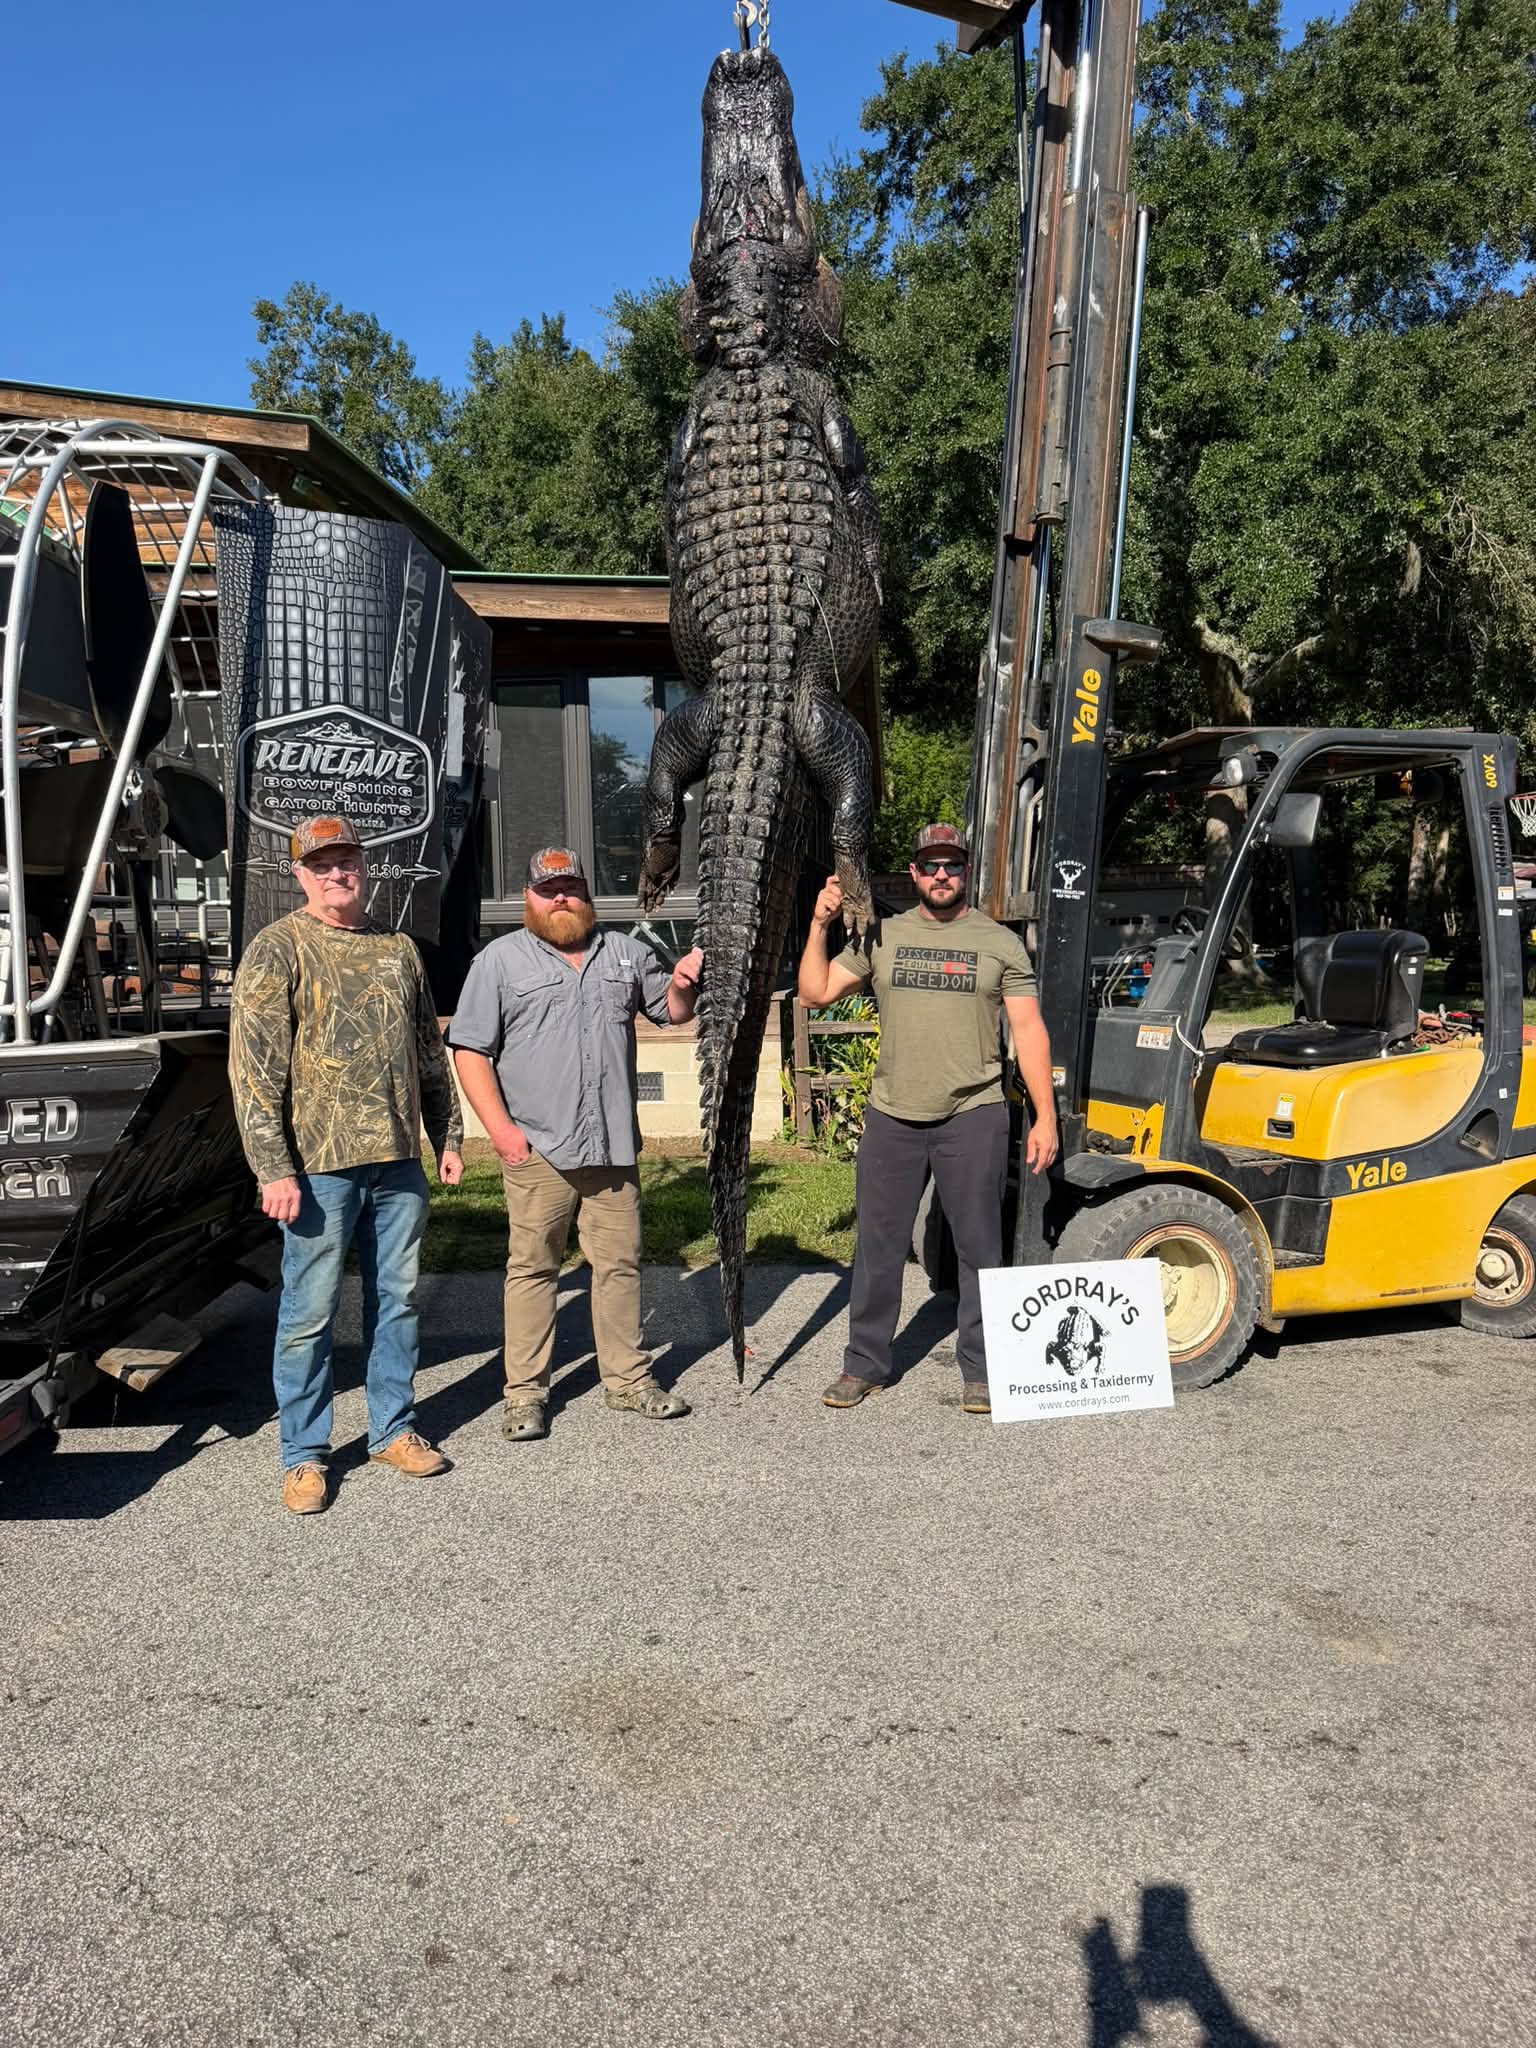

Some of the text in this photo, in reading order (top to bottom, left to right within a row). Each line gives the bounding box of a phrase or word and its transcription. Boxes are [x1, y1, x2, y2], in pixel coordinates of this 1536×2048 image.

[1072, 668, 1101, 744] Yale
[256, 740, 417, 780] RENEGADE
[1482, 753, 1498, 788] 60VX
[264, 776, 412, 796] BOWFISHING
[333, 790, 350, 802] &
[264, 797, 412, 816] GATOR HUNTS
[898, 947, 976, 964] DISCIPLINE
[903, 960, 942, 970] EQUALS
[895, 970, 973, 990] FREEDOM
[0, 1098, 79, 1144] ED
[1346, 1157, 1408, 1190] Yale
[1011, 1276, 1140, 1332] CORDRAY'S
[1009, 1374, 1154, 1396] Processing & Taxidermy
[1038, 1393, 1131, 1411] www.cordrays.com
